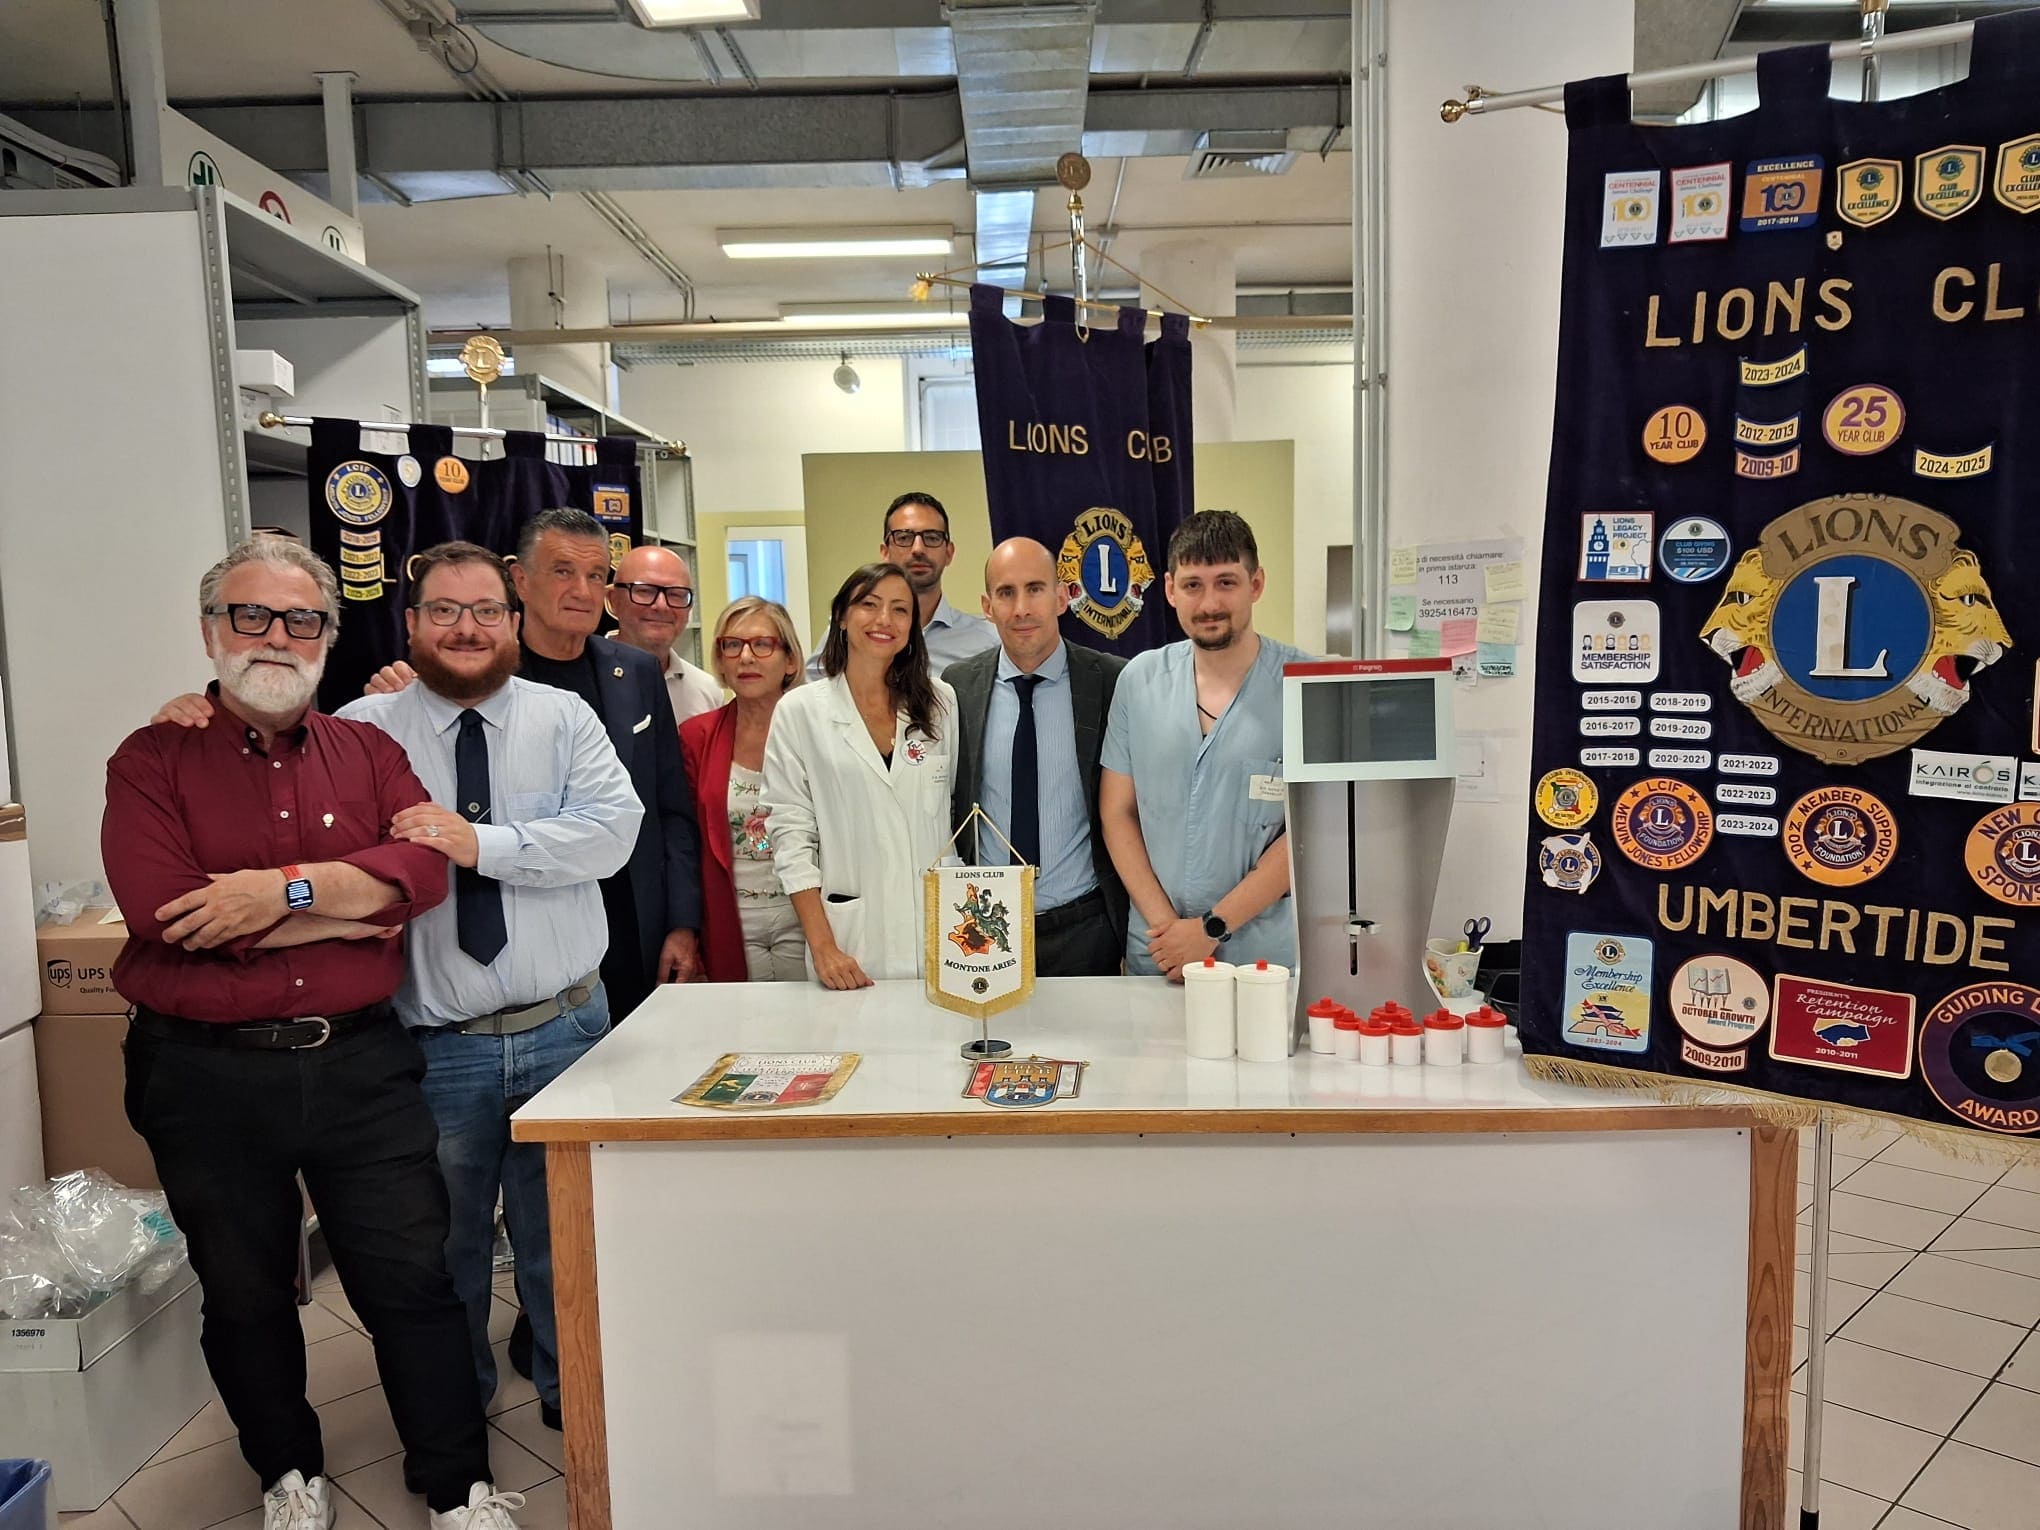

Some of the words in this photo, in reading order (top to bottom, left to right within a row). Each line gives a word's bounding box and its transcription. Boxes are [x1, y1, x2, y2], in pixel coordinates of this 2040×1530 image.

[1757, 160, 1815, 172] EXCELLENCE
[1608, 180, 1656, 190] CENTENNIAL
[1676, 174, 1725, 186] CENTENNIAL
[1939, 183, 1958, 192] CLUB
[1860, 192, 1878, 201] CLUB
[1926, 189, 1970, 201] EXCELLENCE
[1847, 200, 1889, 210] EXCELLENCE
[1757, 216, 1799, 226] 2017-2018
[1645, 278, 1852, 347] LIONS
[1933, 262, 2040, 322] CL
[1744, 358, 1801, 381] 2023-2024
[1840, 396, 1887, 428] 25
[1659, 411, 1692, 440] 10
[1009, 420, 1089, 455] LIONS
[1739, 423, 1794, 441] 2012-2013
[1838, 429, 1860, 442] YEAR
[1863, 429, 1885, 442] CLUB
[1650, 441, 1673, 450] YEAR
[1677, 439, 1699, 449] CLUB
[346, 463, 371, 473] LCIF
[444, 462, 461, 477] 10
[1741, 454, 1793, 476] 2009-10
[1919, 455, 1986, 474] 2024-2025
[1081, 513, 1127, 540] LIONS
[1613, 524, 1643, 532] LEGACY
[1778, 507, 1939, 562] LIONS
[1429, 552, 1464, 563] necessità
[1098, 544, 1117, 593] L
[1426, 564, 1446, 574] prima
[1438, 574, 1458, 584] 113
[1422, 598, 1431, 606] Se
[1433, 597, 1474, 606] necessario
[1083, 603, 1132, 628] INTERNATIONAL
[1418, 606, 1478, 618] 3925416473
[1809, 576, 1888, 677] L
[1582, 653, 1650, 661] MEMBERSHIP
[1580, 661, 1650, 669] SATISFACTION
[1587, 696, 1636, 704] 2015-2016
[1655, 697, 1706, 707] 2018-2019
[1760, 685, 1931, 743] INTERNATIONAL
[1585, 722, 1634, 730] 2016-2017
[1655, 723, 1706, 734] 2019-2020
[1585, 753, 1634, 761] 2017-2018
[1655, 754, 1706, 763] 2020-2021
[1723, 760, 1773, 770] 2021-2022
[1645, 780, 1682, 792] LCIF
[1916, 780, 1961, 789] integrazione
[1721, 789, 1771, 800] 2022-2023
[1655, 808, 1669, 826] L
[1828, 809, 1857, 819] LIONS
[1720, 820, 1773, 831] 2023-2024
[1799, 790, 1862, 816] MEMBER
[1867, 803, 1892, 867] SUPPORT
[1833, 820, 1848, 839] L
[1978, 808, 2021, 840] NEW
[1615, 803, 1631, 846] MELVIN
[1627, 847, 1662, 867] JONES
[1667, 811, 1710, 867] FELLOWSHIP
[1639, 832, 1683, 848] FOUNDATION
[1815, 846, 1863, 862] FOUNDATION
[2021, 841, 2037, 861] L
[955, 871, 981, 879] LIONS
[1658, 883, 2015, 972] UMBERTIDE
[944, 959, 990, 973] MONTONE
[992, 957, 1017, 972] ARIES
[50, 969, 70, 983] ups
[78, 968, 105, 980] UPS
[1574, 965, 1643, 985] Membership
[80, 986, 104, 994] Quality
[1581, 978, 1636, 993] Excellence
[1796, 993, 1883, 1014] Retention
[1937, 988, 2024, 1025] GUIDING
[1682, 1006, 1717, 1019] OCTOBER
[1720, 1011, 1755, 1024] GROWTH
[1806, 1004, 1898, 1028] Campaign
[1707, 1017, 1726, 1026] Award
[1685, 1046, 1742, 1068] 2009-2010
[1815, 1047, 1858, 1059] 2010-2011
[1958, 1098, 2039, 1126] AWARD
[12, 1329, 45, 1337] 1356976
